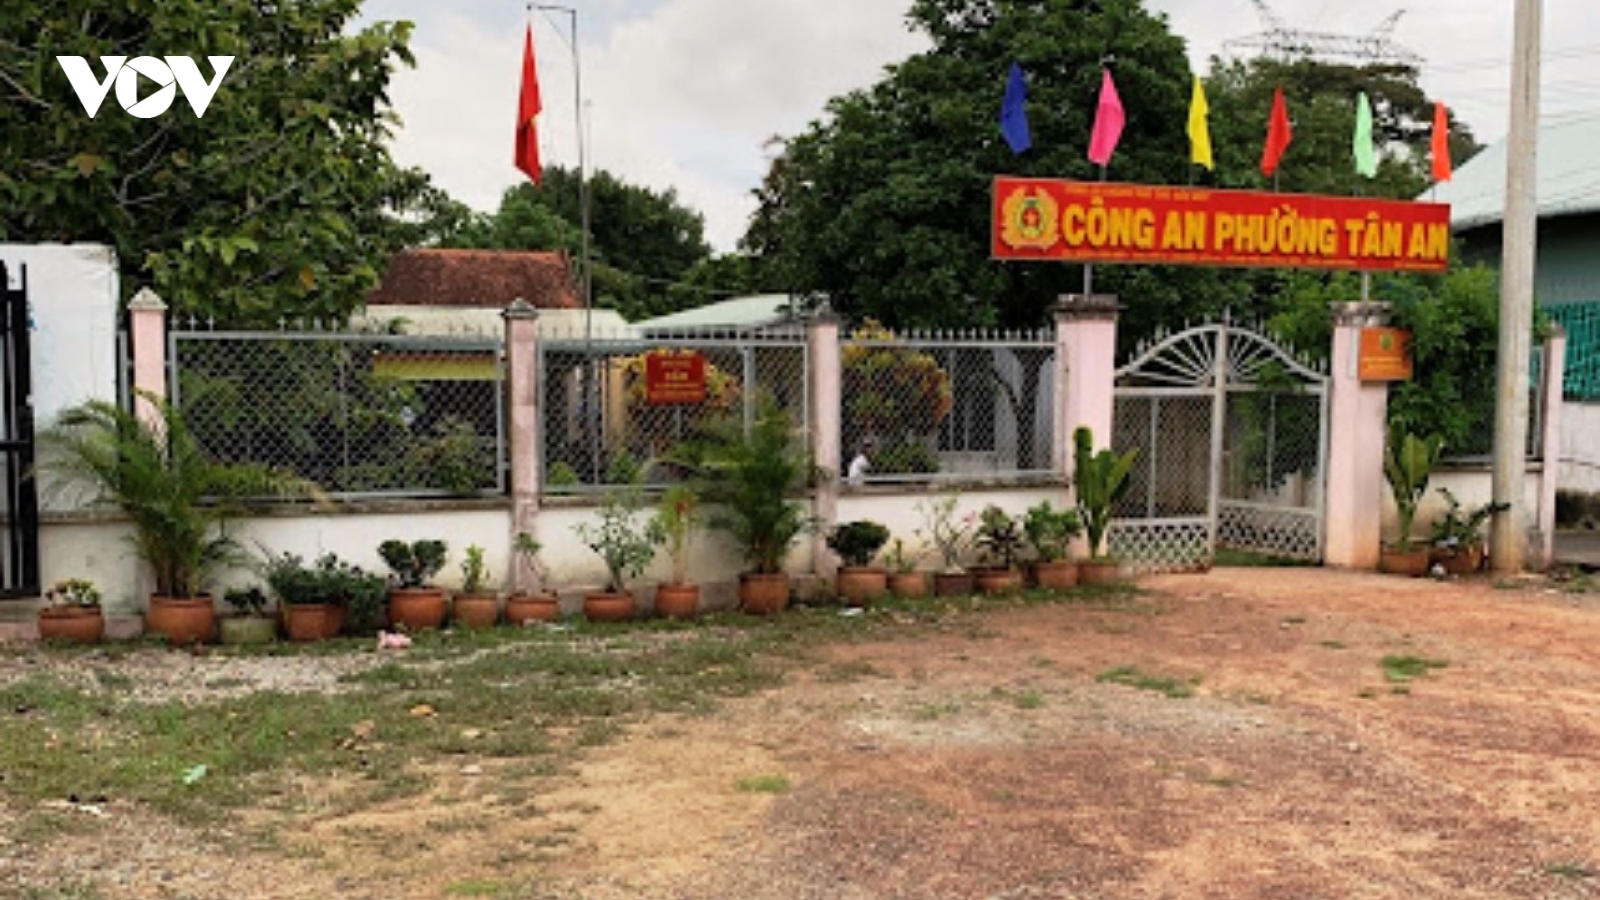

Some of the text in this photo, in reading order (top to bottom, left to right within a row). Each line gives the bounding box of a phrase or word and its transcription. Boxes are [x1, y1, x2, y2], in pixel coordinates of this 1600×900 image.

[1062, 195, 1155, 247] CÔNG
[1162, 210, 1208, 250] AN
[1214, 204, 1337, 255] PHƯỜNG
[1345, 211, 1403, 257] TÂN
[1408, 222, 1448, 260] AN
